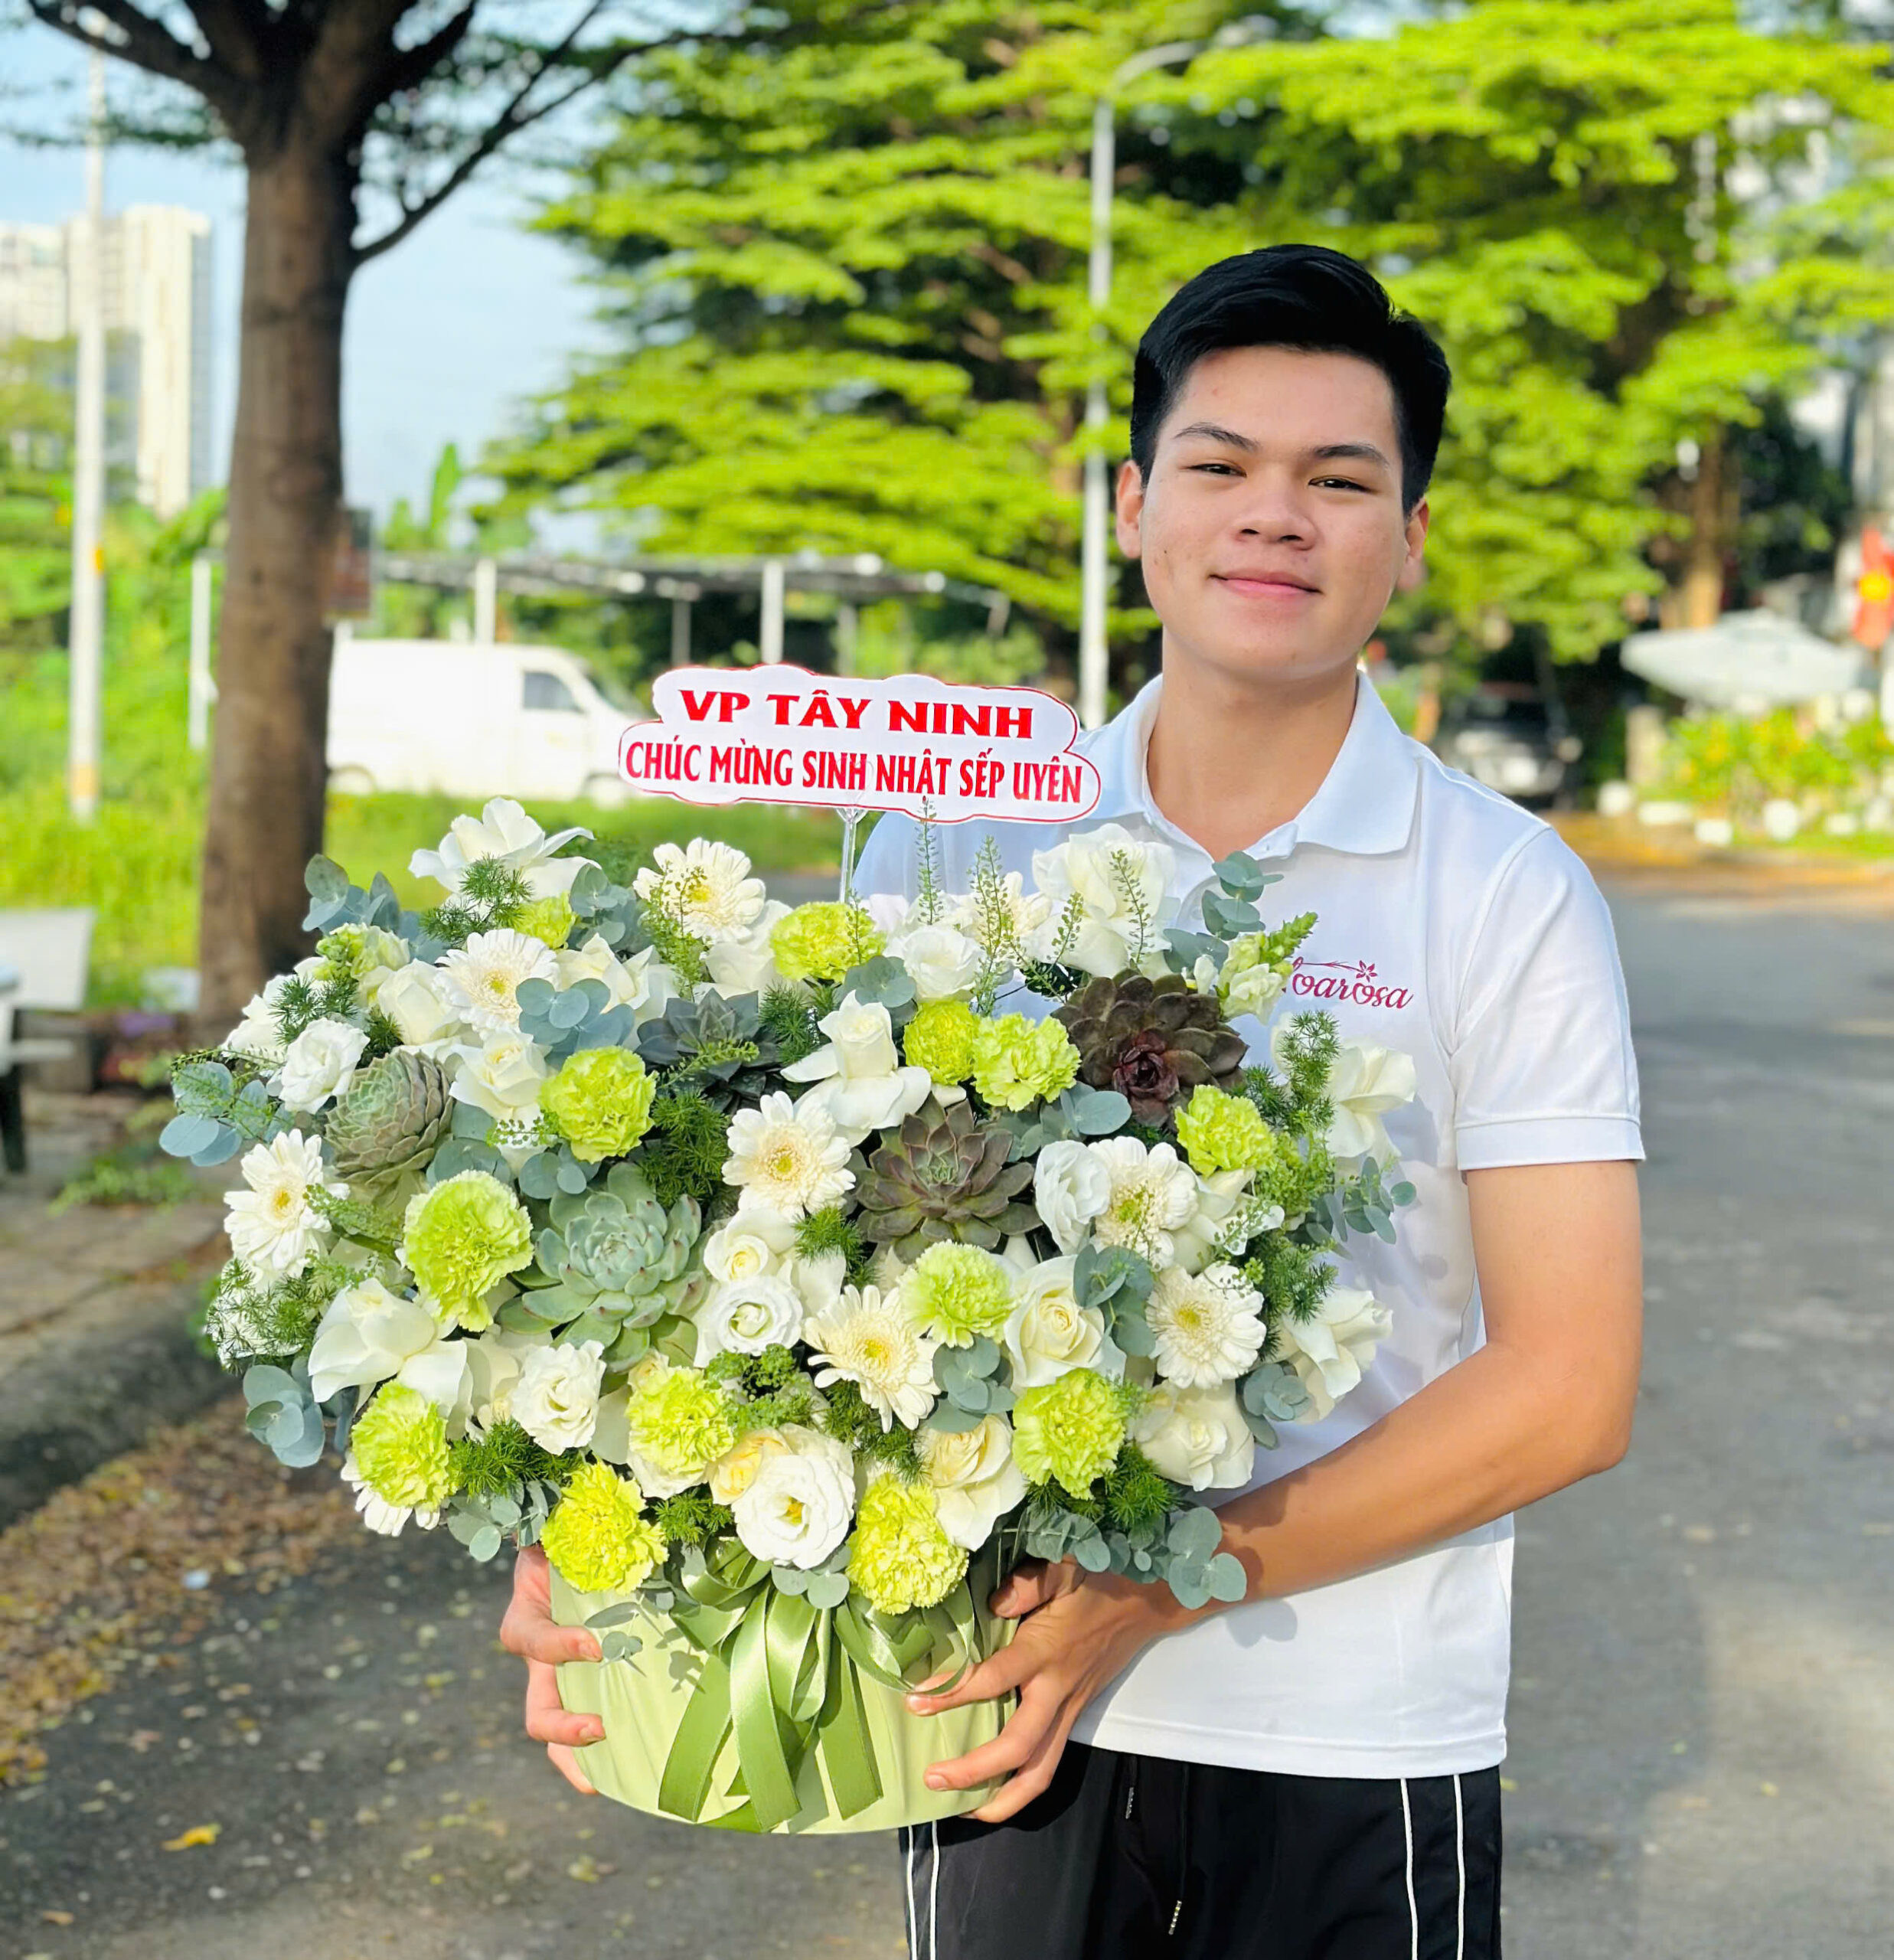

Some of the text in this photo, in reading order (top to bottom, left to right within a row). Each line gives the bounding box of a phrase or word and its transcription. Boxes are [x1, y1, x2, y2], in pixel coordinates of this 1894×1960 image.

[679, 689, 1033, 739] VP TÂY NINH
[625, 735, 702, 782] CHÚC
[709, 738, 793, 786] MỪNG
[802, 750, 868, 792] SINH
[959, 748, 1005, 799] SẾP
[1013, 756, 1083, 803] UYÊN
[1282, 957, 1414, 1009] oarosa
